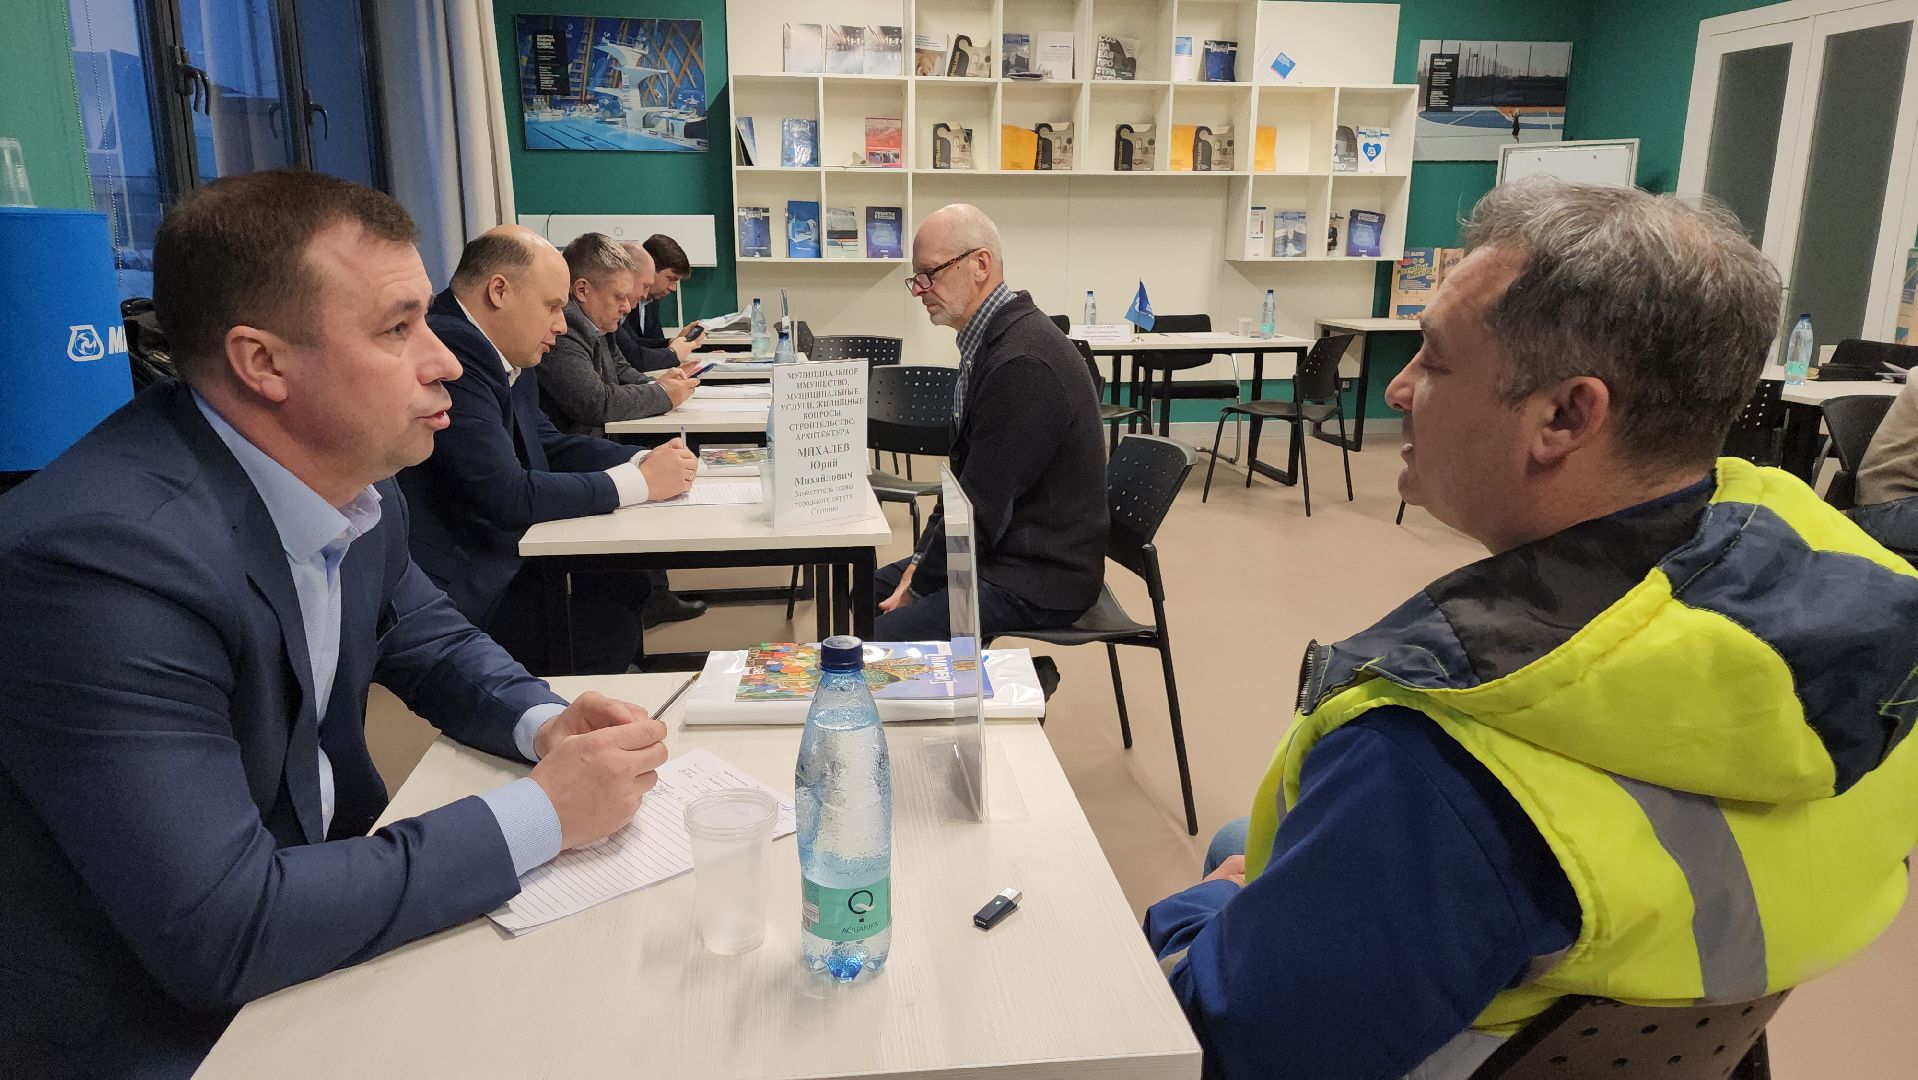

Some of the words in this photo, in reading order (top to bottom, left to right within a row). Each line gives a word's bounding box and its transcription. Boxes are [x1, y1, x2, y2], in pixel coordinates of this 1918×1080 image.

[795, 429, 850, 440] АРХИТЕКТУРА
[797, 443, 850, 457] МИХАЛЕВ
[810, 458, 838, 471] Юрий
[795, 472, 853, 486] Михайлович
